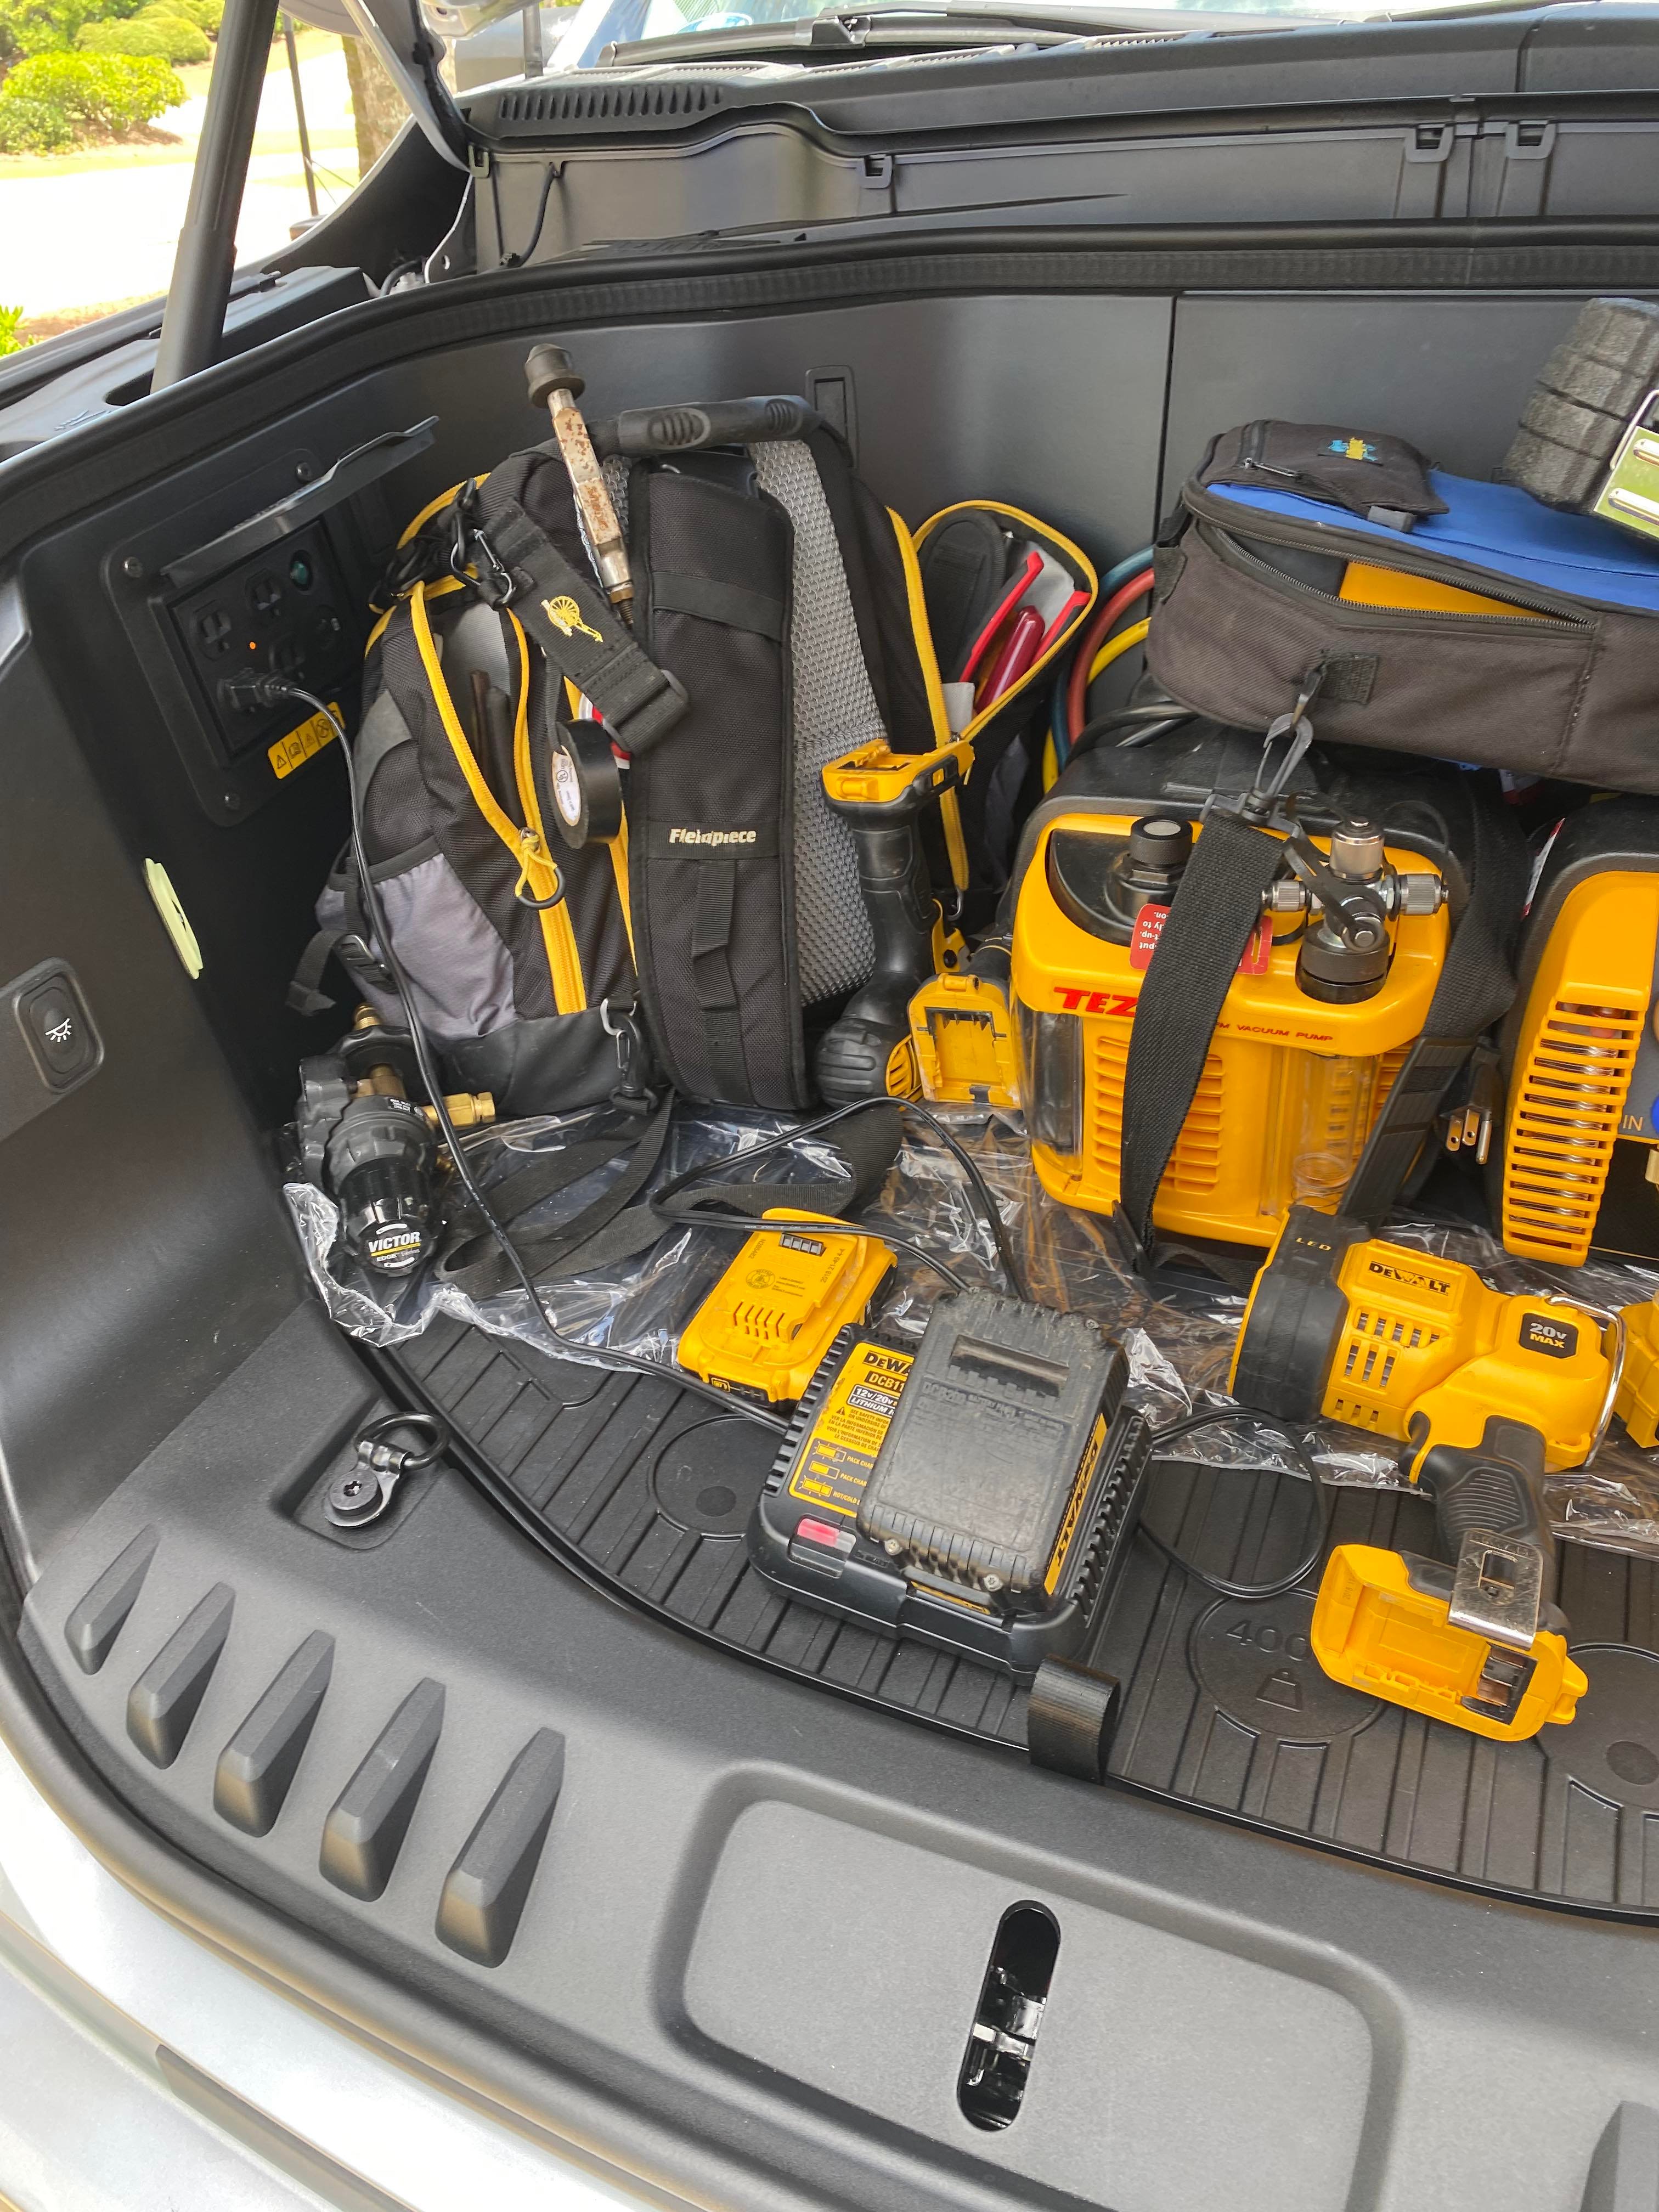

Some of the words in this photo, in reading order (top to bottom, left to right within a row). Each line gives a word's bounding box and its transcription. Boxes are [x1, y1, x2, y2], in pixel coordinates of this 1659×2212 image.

[669, 828, 757, 847] Fieldpiece
[1142, 921, 1152, 930] to
[1053, 986, 1139, 1017] TEZ
[1237, 1024, 1290, 1036] VACUUM
[1295, 1031, 1334, 1041] PUMP
[1622, 1114, 1644, 1131] IN
[368, 1231, 421, 1253] VICTOR
[1295, 1237, 1332, 1251] LED
[1368, 1261, 1451, 1295] DEWALT
[1529, 1333, 1565, 1349] MAX
[868, 1372, 905, 1392] DCB11
[851, 1397, 889, 1413] LITHIUM
[876, 1417, 889, 1425] INFOR
[847, 1455, 860, 1465] PACK
[860, 1460, 874, 1470] CHAR
[840, 1472, 853, 1482] PACK
[853, 1478, 868, 1487] CHAR
[832, 1491, 857, 1505] HOT/COLD
[1225, 1618, 1311, 1662] 400
